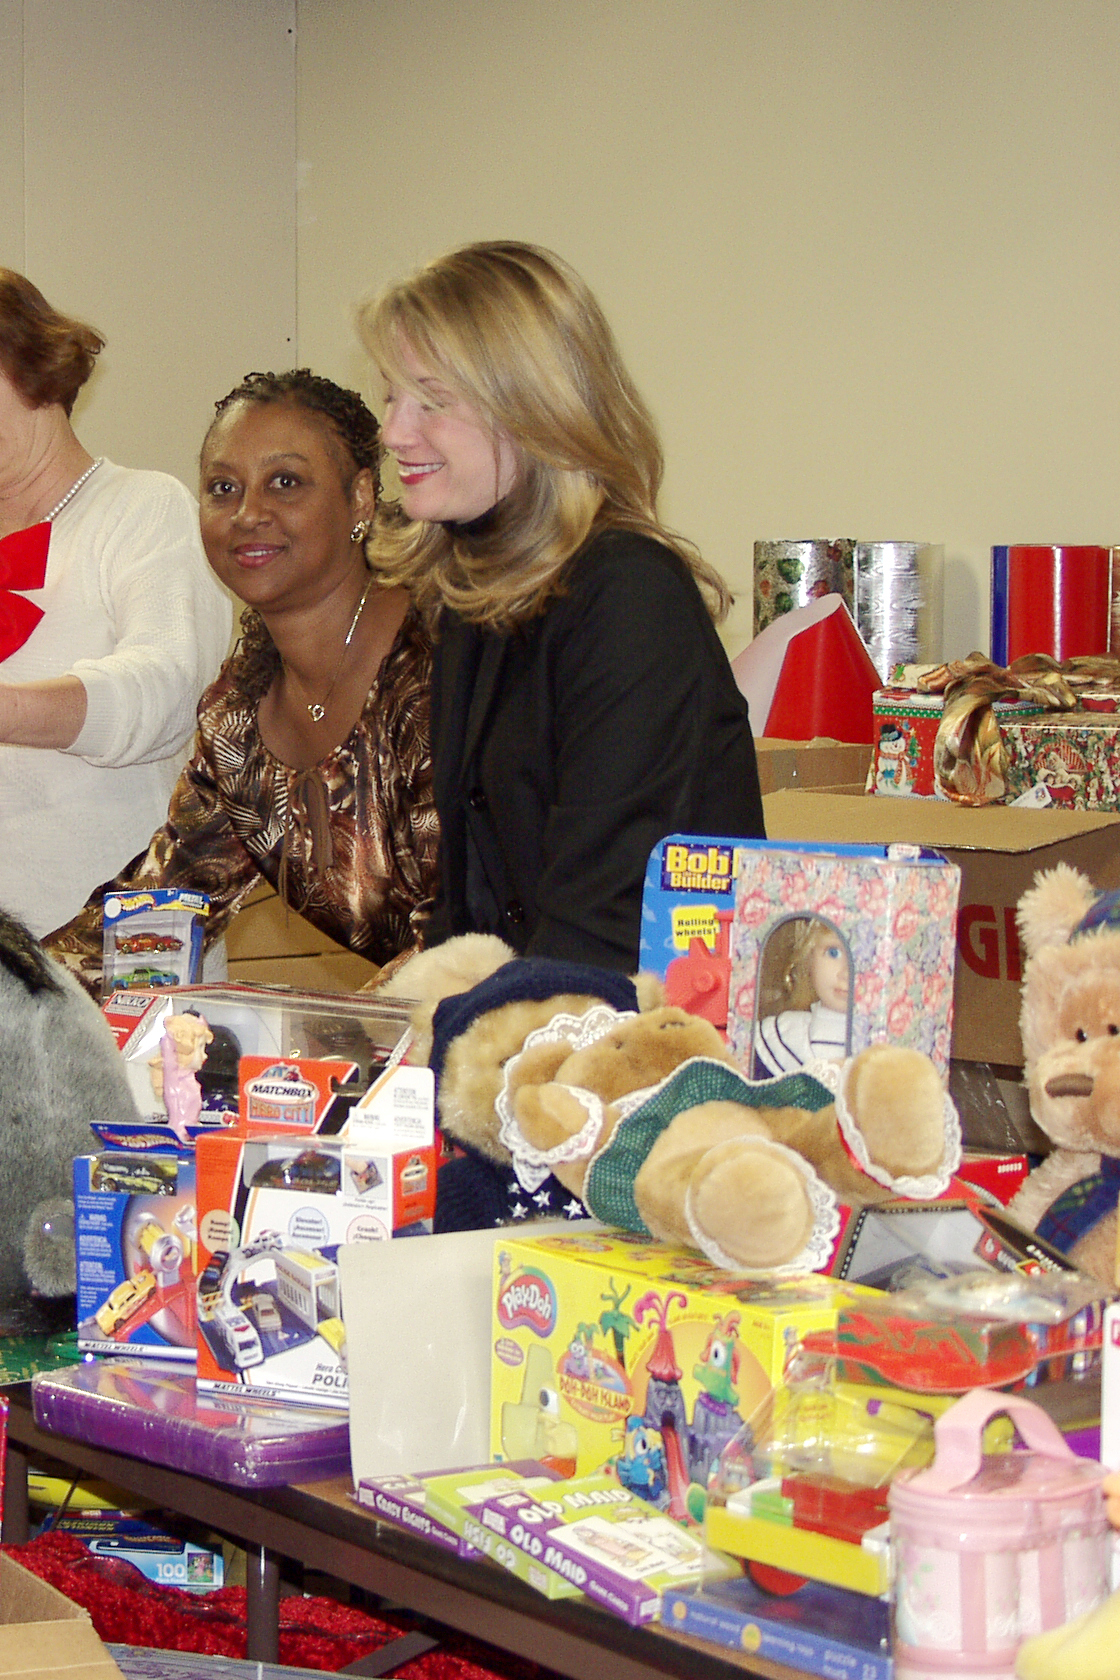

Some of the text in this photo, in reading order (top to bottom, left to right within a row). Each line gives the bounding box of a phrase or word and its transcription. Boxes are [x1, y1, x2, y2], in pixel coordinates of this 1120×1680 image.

[666, 845, 730, 876] Bob
[670, 872, 731, 890] Builder
[251, 1084, 313, 1098] MATCHBOX
[502, 1283, 552, 1320] Play-Doh
[214, 1383, 276, 1397] MATTEL WHEELS
[312, 1373, 349, 1388] POLI
[517, 1489, 632, 1523] OLD MAID
[496, 1544, 516, 1569] GO
[510, 1524, 543, 1556] OLD
[544, 1546, 588, 1586] MAID
[156, 1563, 185, 1578] 100
